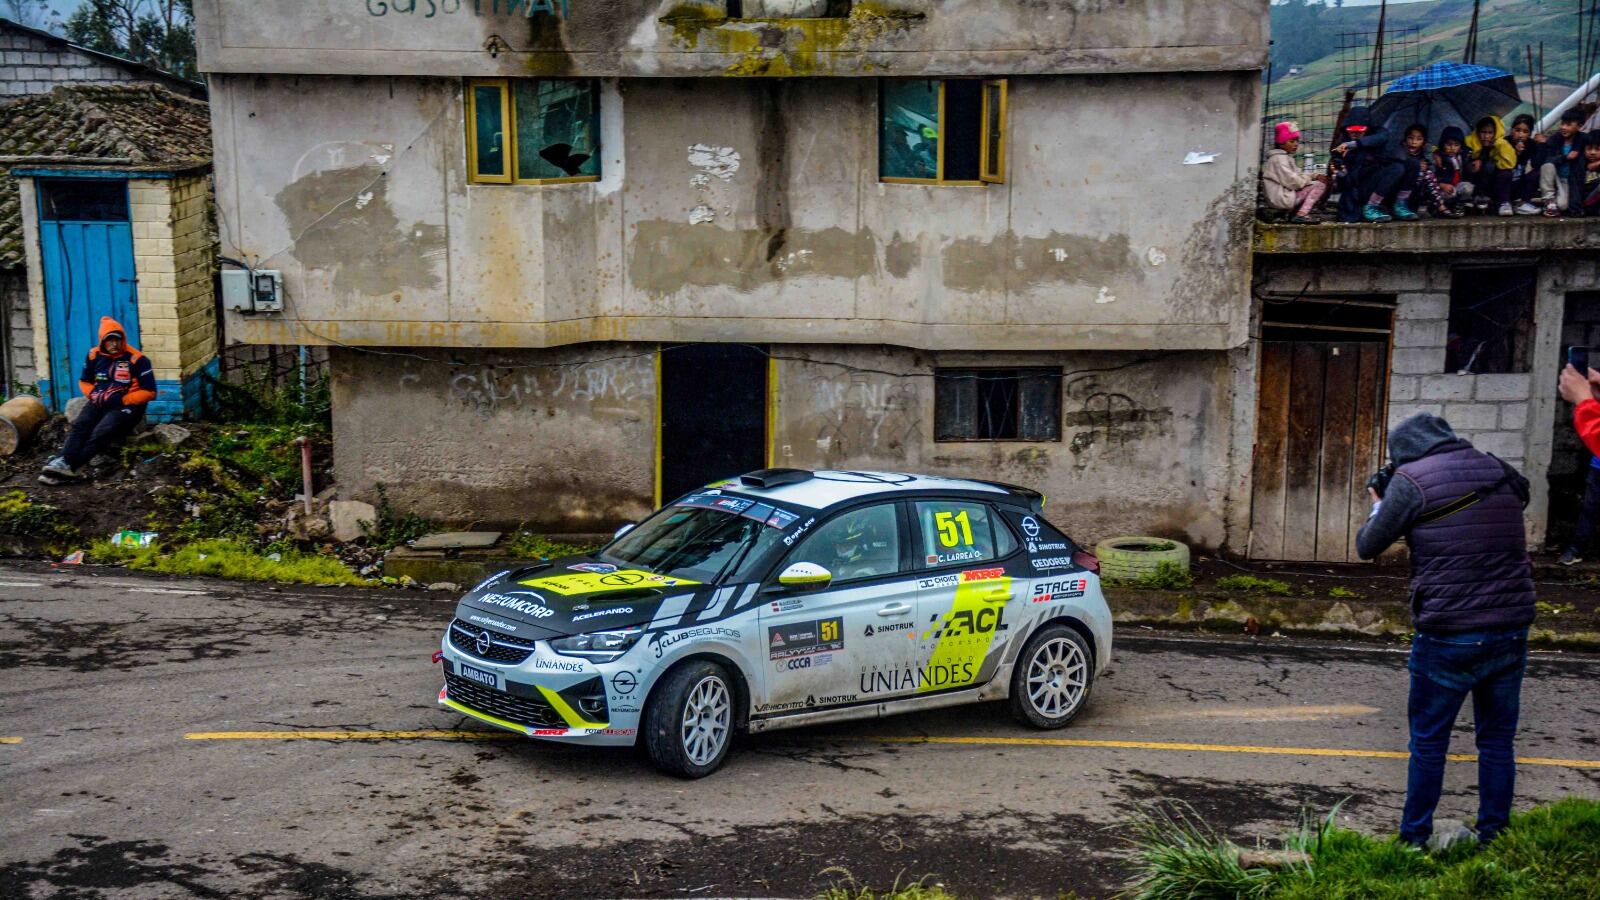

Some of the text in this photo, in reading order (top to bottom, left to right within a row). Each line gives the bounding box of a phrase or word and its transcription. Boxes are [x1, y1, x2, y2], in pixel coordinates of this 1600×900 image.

[791, 516, 815, 540] opel_ecu
[935, 511, 974, 547] 51
[946, 552, 973, 561] LARREA
[934, 575, 958, 583] CHOICE
[963, 568, 1005, 581] MRF
[1033, 579, 1087, 595] STAGE3
[477, 592, 555, 619] NEXUMCORP
[572, 607, 634, 622] ACELERANDO
[948, 607, 1009, 636] ACL
[821, 620, 838, 641] 51
[877, 621, 914, 633] SINOTRUK
[920, 633, 1009, 650] MOTORSPORT
[535, 657, 584, 673] UNIANDES
[788, 656, 811, 670] CCCA
[861, 655, 975, 673] UNIVERSIDAD
[463, 665, 495, 687] AMBATO
[860, 662, 973, 694] UNIANDES
[819, 694, 858, 704] SINOTRUK
[532, 728, 569, 736] MRF
